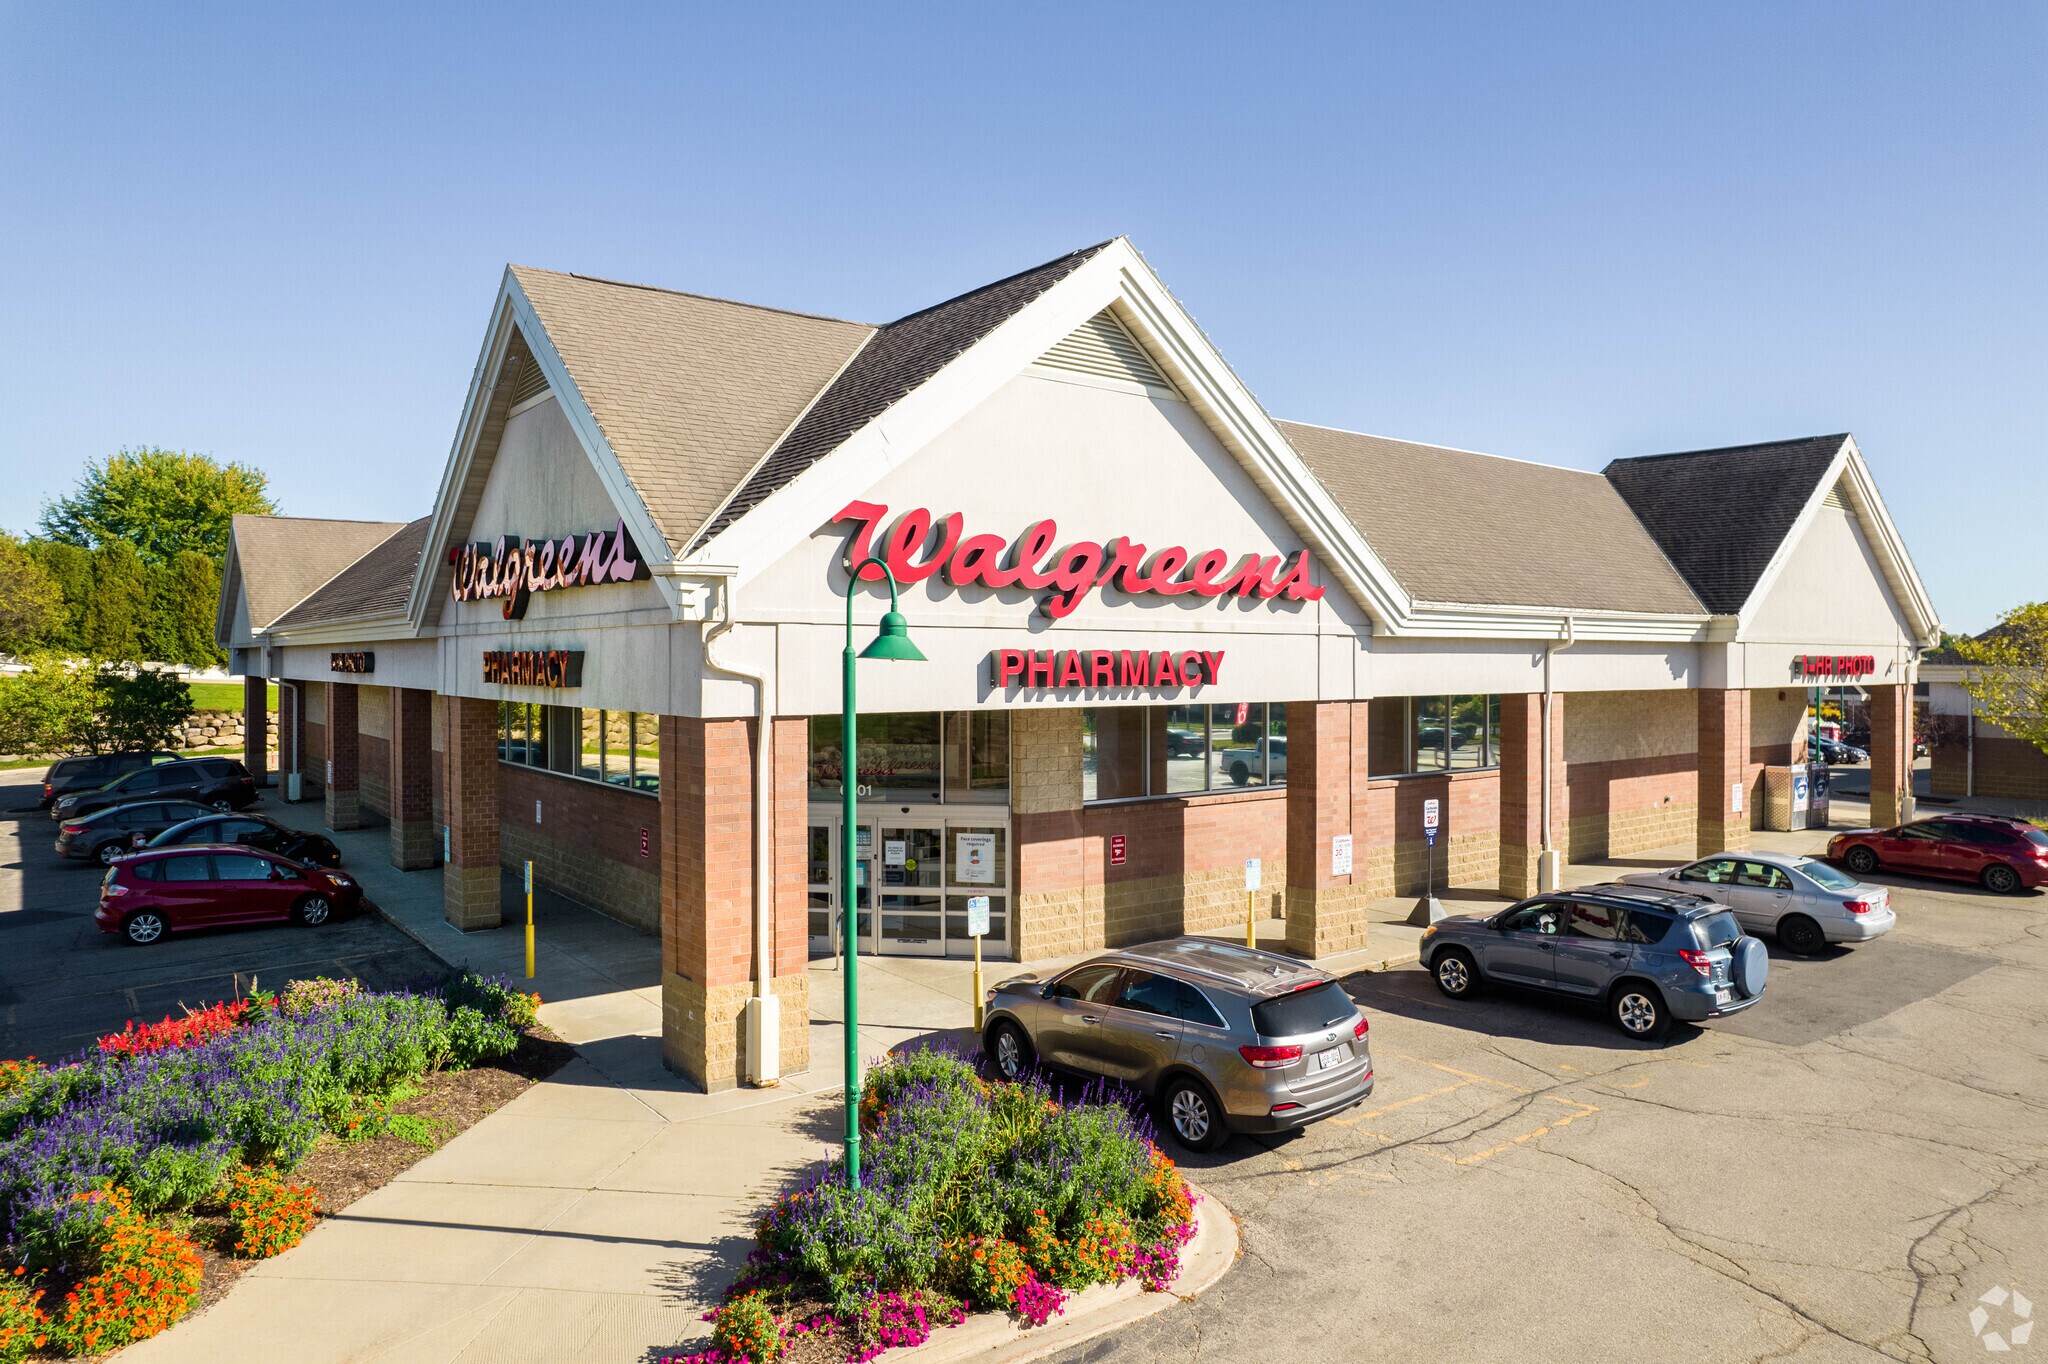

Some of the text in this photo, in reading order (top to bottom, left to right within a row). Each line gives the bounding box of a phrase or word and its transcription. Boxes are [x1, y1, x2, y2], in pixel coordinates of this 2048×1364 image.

[448, 517, 638, 620] Walgreens
[833, 500, 1326, 619] Walgreens
[483, 650, 570, 688] PHARMACY
[1000, 649, 1225, 687] PHARMACY
[1801, 655, 1875, 676] 1-HR PHOTO
[816, 764, 896, 777] Wareens
[839, 784, 872, 796] 01
